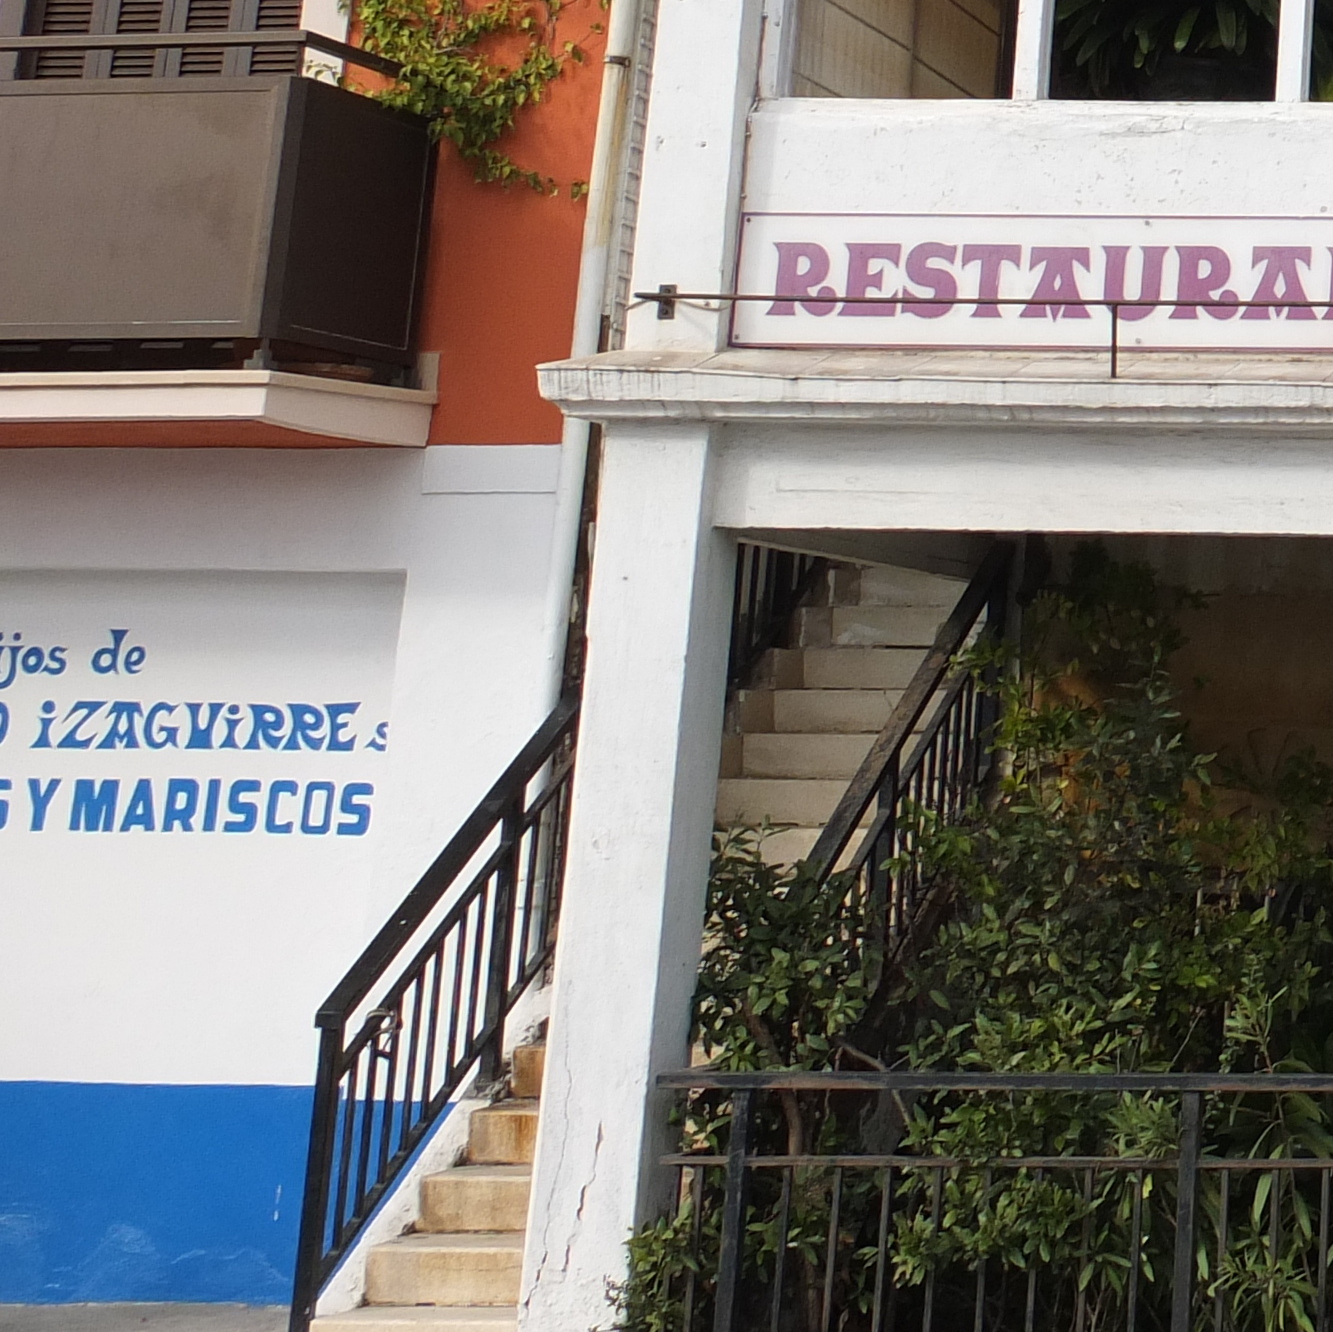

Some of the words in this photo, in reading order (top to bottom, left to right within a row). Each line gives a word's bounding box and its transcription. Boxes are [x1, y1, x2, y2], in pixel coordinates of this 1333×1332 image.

[91, 629, 146, 675] de
[27, 778, 62, 832] Y
[68, 777, 374, 836] MARISCOS
